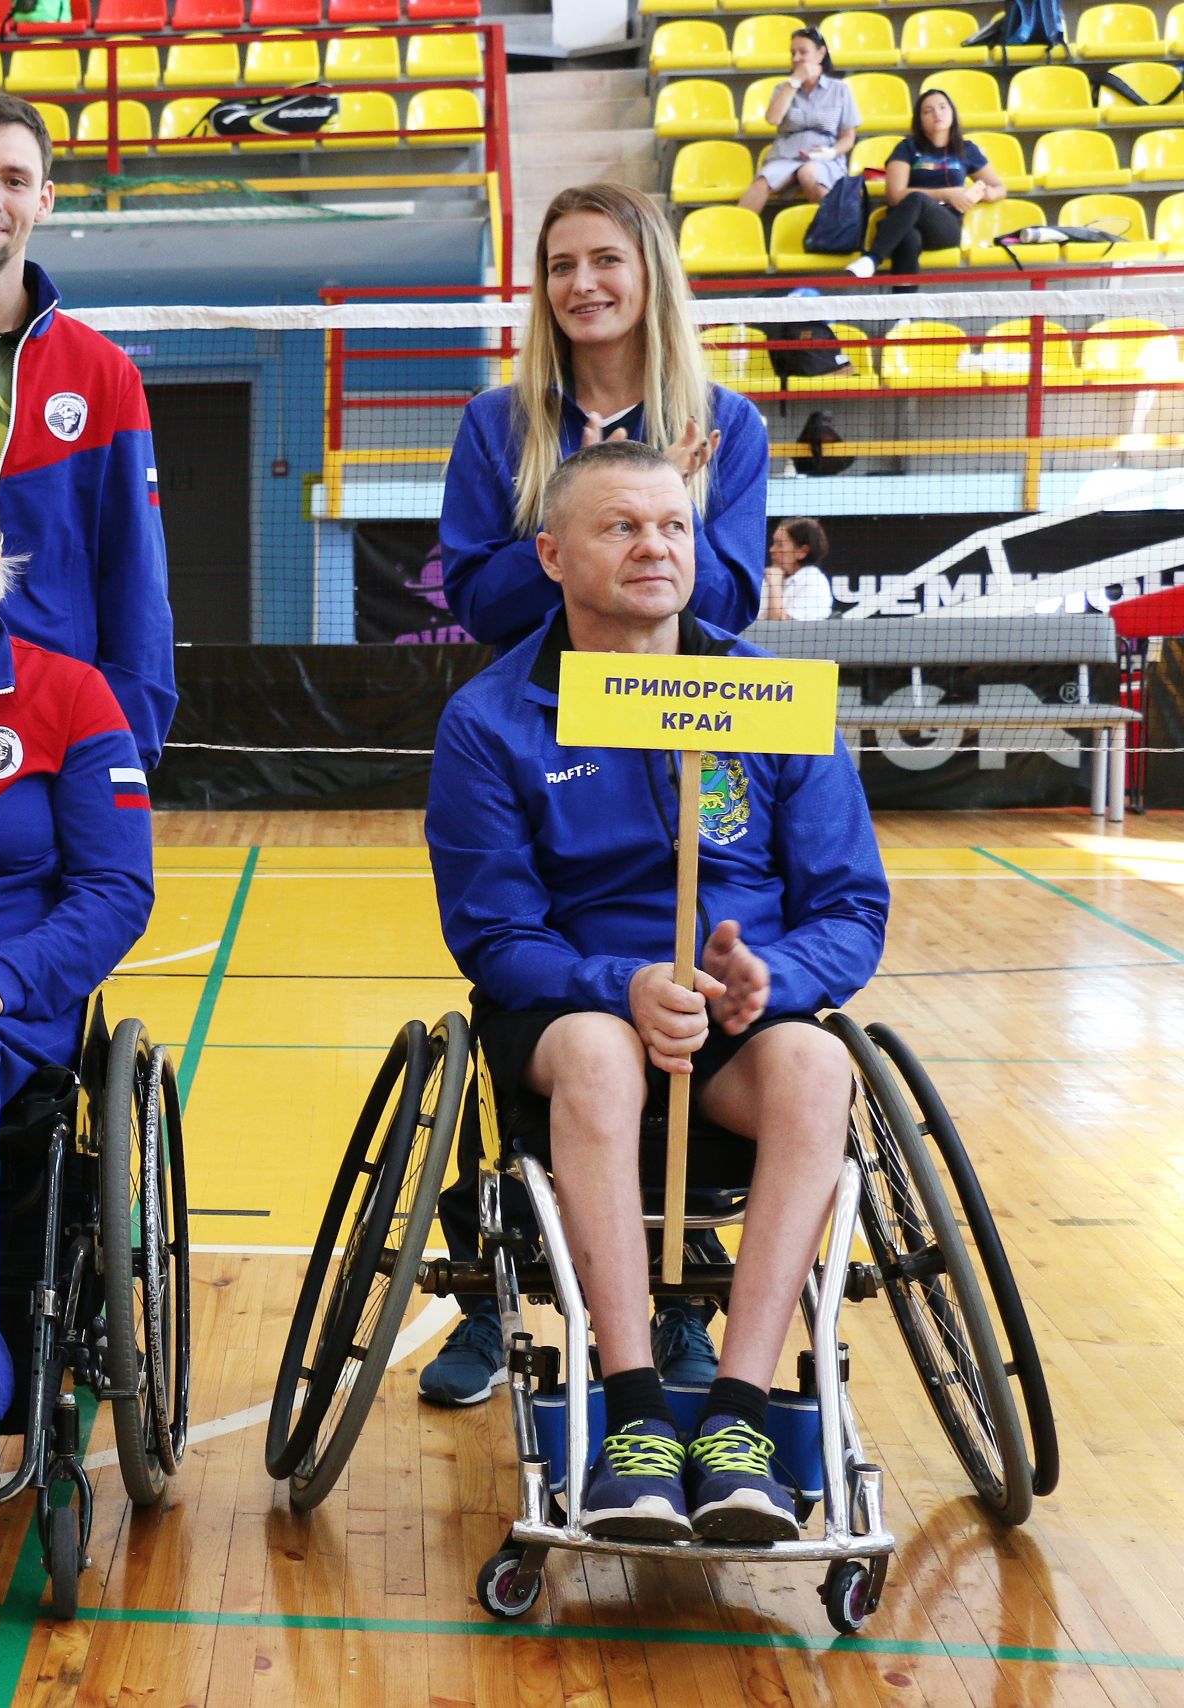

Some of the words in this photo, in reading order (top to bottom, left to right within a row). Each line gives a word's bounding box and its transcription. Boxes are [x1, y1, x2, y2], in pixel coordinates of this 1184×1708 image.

[604, 676, 794, 703] ПРИМОРСКИЙ
[661, 710, 733, 733] КРАЙ
[544, 764, 584, 784] RAFT
